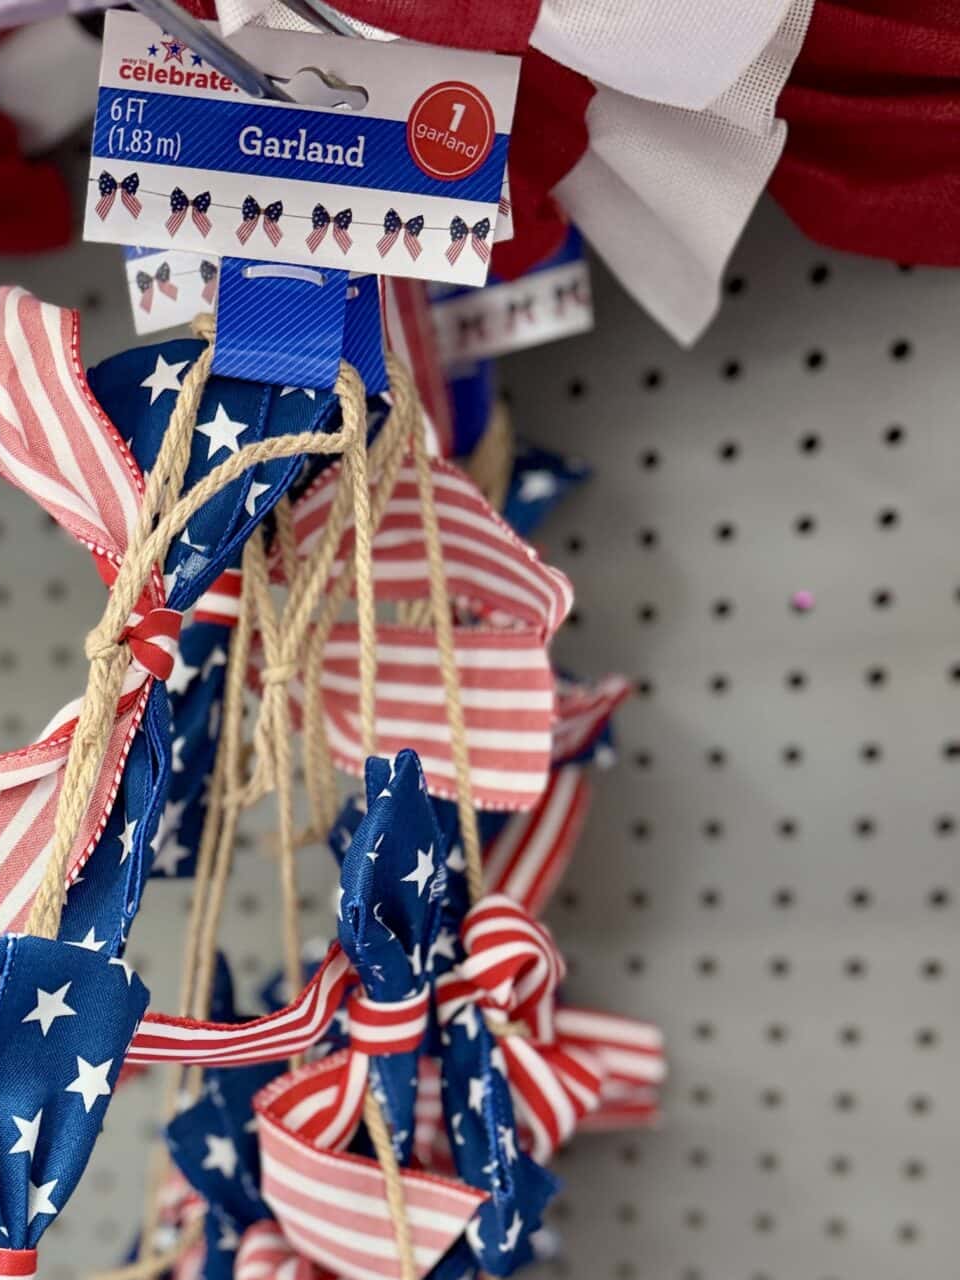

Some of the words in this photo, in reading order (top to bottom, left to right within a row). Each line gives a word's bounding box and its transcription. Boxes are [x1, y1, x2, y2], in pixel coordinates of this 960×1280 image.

[110, 97, 122, 121] 6
[126, 97, 148, 124] FT
[449, 103, 466, 132] 1
[108, 124, 153, 155] (1.83
[156, 131, 182, 161] m)
[238, 125, 365, 168] Garland
[415, 122, 479, 159] garland
